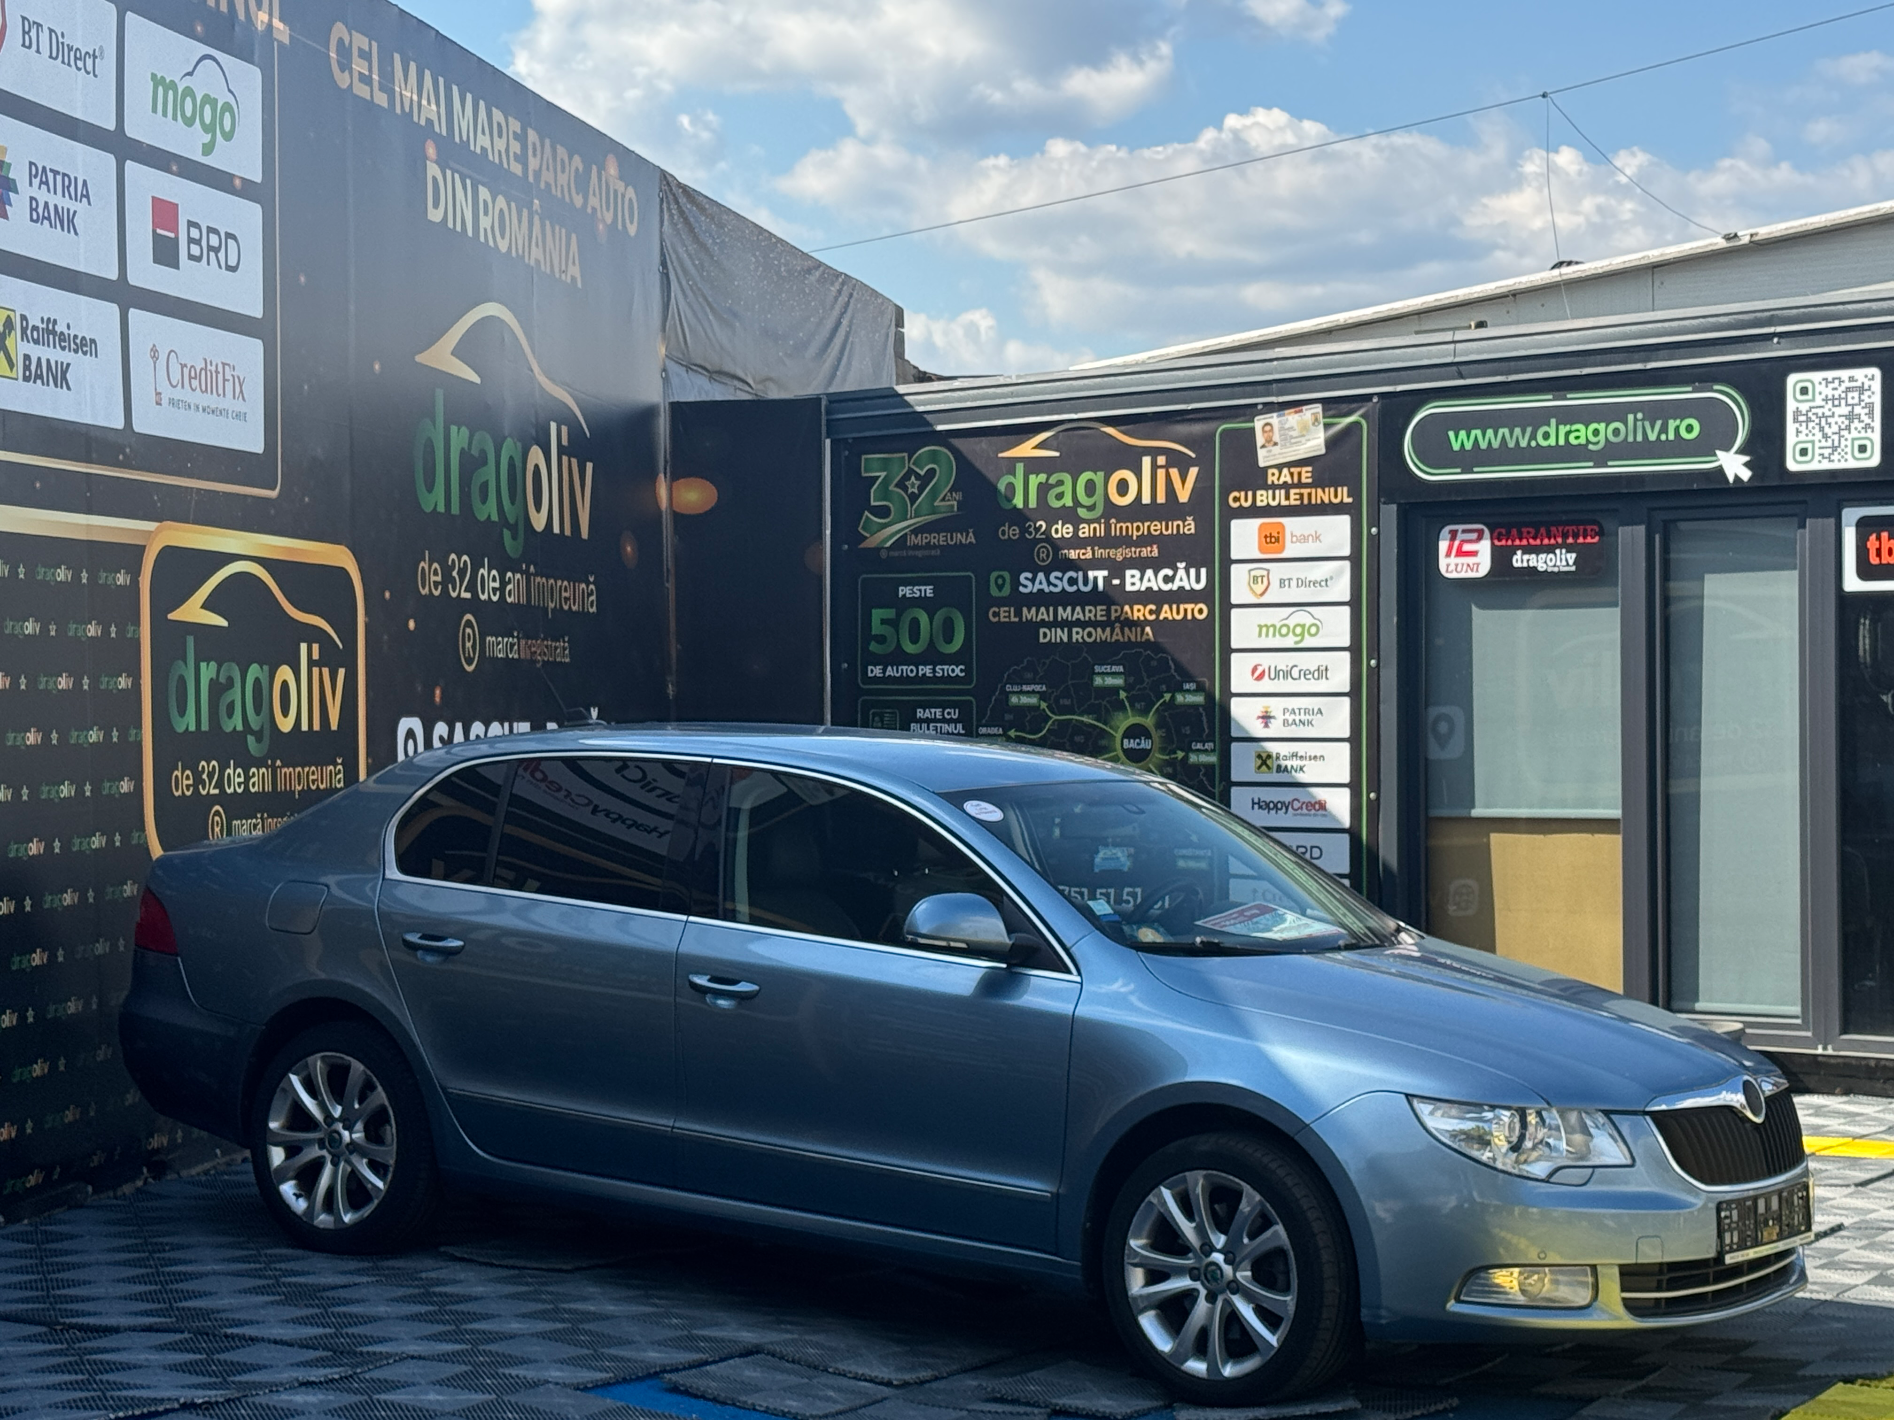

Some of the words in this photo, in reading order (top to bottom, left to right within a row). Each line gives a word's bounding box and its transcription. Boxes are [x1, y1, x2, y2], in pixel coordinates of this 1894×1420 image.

[20, 14, 44, 55] BT
[150, 72, 236, 157] mogo
[329, 21, 388, 109] CEL
[393, 52, 447, 137] MAI
[452, 84, 523, 178] MARE
[527, 127, 584, 208] PARC
[587, 164, 639, 238] AUTO
[28, 160, 92, 207] PATRIA
[29, 196, 79, 237] BANK
[426, 160, 473, 237] DIN
[478, 184, 582, 289] ROMÂNIA
[187, 219, 241, 273] BRD
[20, 313, 98, 358] Raiffeisen
[22, 353, 71, 391] BANK
[166, 349, 247, 403] CreditFix
[168, 397, 192, 412] PRIETEN
[1447, 412, 1700, 452] www.dragoliv.ro
[414, 387, 594, 559] dragoliv
[1267, 467, 1313, 485] RATE
[858, 446, 957, 537] 32
[997, 455, 1199, 520] dragoliv
[1228, 491, 1253, 508] CU
[1256, 487, 1353, 507] BULETINUL
[907, 528, 976, 546] ÎMPREUNĂ
[999, 523, 1019, 540] de
[1024, 521, 1046, 539] 32
[1051, 520, 1073, 538] de
[1078, 520, 1105, 538] ani
[1109, 516, 1195, 541] împreună
[1263, 531, 1280, 545] tbi
[1290, 531, 1322, 544] bank
[1445, 528, 1484, 558] 12
[1493, 525, 1599, 546] GARANTIE
[1059, 546, 1092, 560] marcă
[1094, 545, 1158, 563] înregistrată
[1512, 548, 1577, 571] dragoliv
[1019, 570, 1108, 593] SASCUT
[1125, 562, 1207, 591] BACĂU
[1445, 562, 1481, 574] LUNI
[418, 550, 442, 597] de
[448, 552, 472, 599] 32
[478, 557, 500, 603] de
[505, 563, 527, 605] ani
[529, 565, 597, 618] împreună
[898, 585, 934, 598] PESTE
[1252, 575, 1265, 585] BT
[1279, 578, 1294, 589] BT
[989, 607, 1018, 622] CEL
[1022, 606, 1054, 622] MAI
[1057, 605, 1107, 621] MARE
[1110, 604, 1156, 620] PARC
[1159, 603, 1208, 620] AUTO
[868, 607, 965, 654] 500
[1039, 627, 1070, 643] DIN
[1072, 623, 1154, 643] ROMÂNIA
[1257, 622, 1320, 645] mogo
[486, 632, 518, 659] marcă
[868, 666, 885, 678] DE
[886, 665, 917, 678] AUTO
[919, 665, 932, 677] PE
[934, 665, 965, 677] STOC
[1268, 664, 1329, 681] UniCredit
[168, 635, 346, 757] dragoliv
[916, 708, 943, 719] RATE
[944, 708, 959, 719] CU
[1282, 707, 1323, 717] PATRIA
[1282, 718, 1315, 728] BANK
[910, 723, 965, 734] BULETINUL
[1123, 736, 1152, 749] BACĂU
[1275, 752, 1325, 762] Raiffeisen
[172, 761, 194, 797] de
[199, 760, 220, 796] 32
[224, 759, 244, 793] de
[249, 760, 272, 793] ani
[276, 757, 344, 799] împreună
[1275, 764, 1306, 774] BANK
[1251, 798, 1327, 815] HappyCredit
[232, 813, 263, 837] marcă
